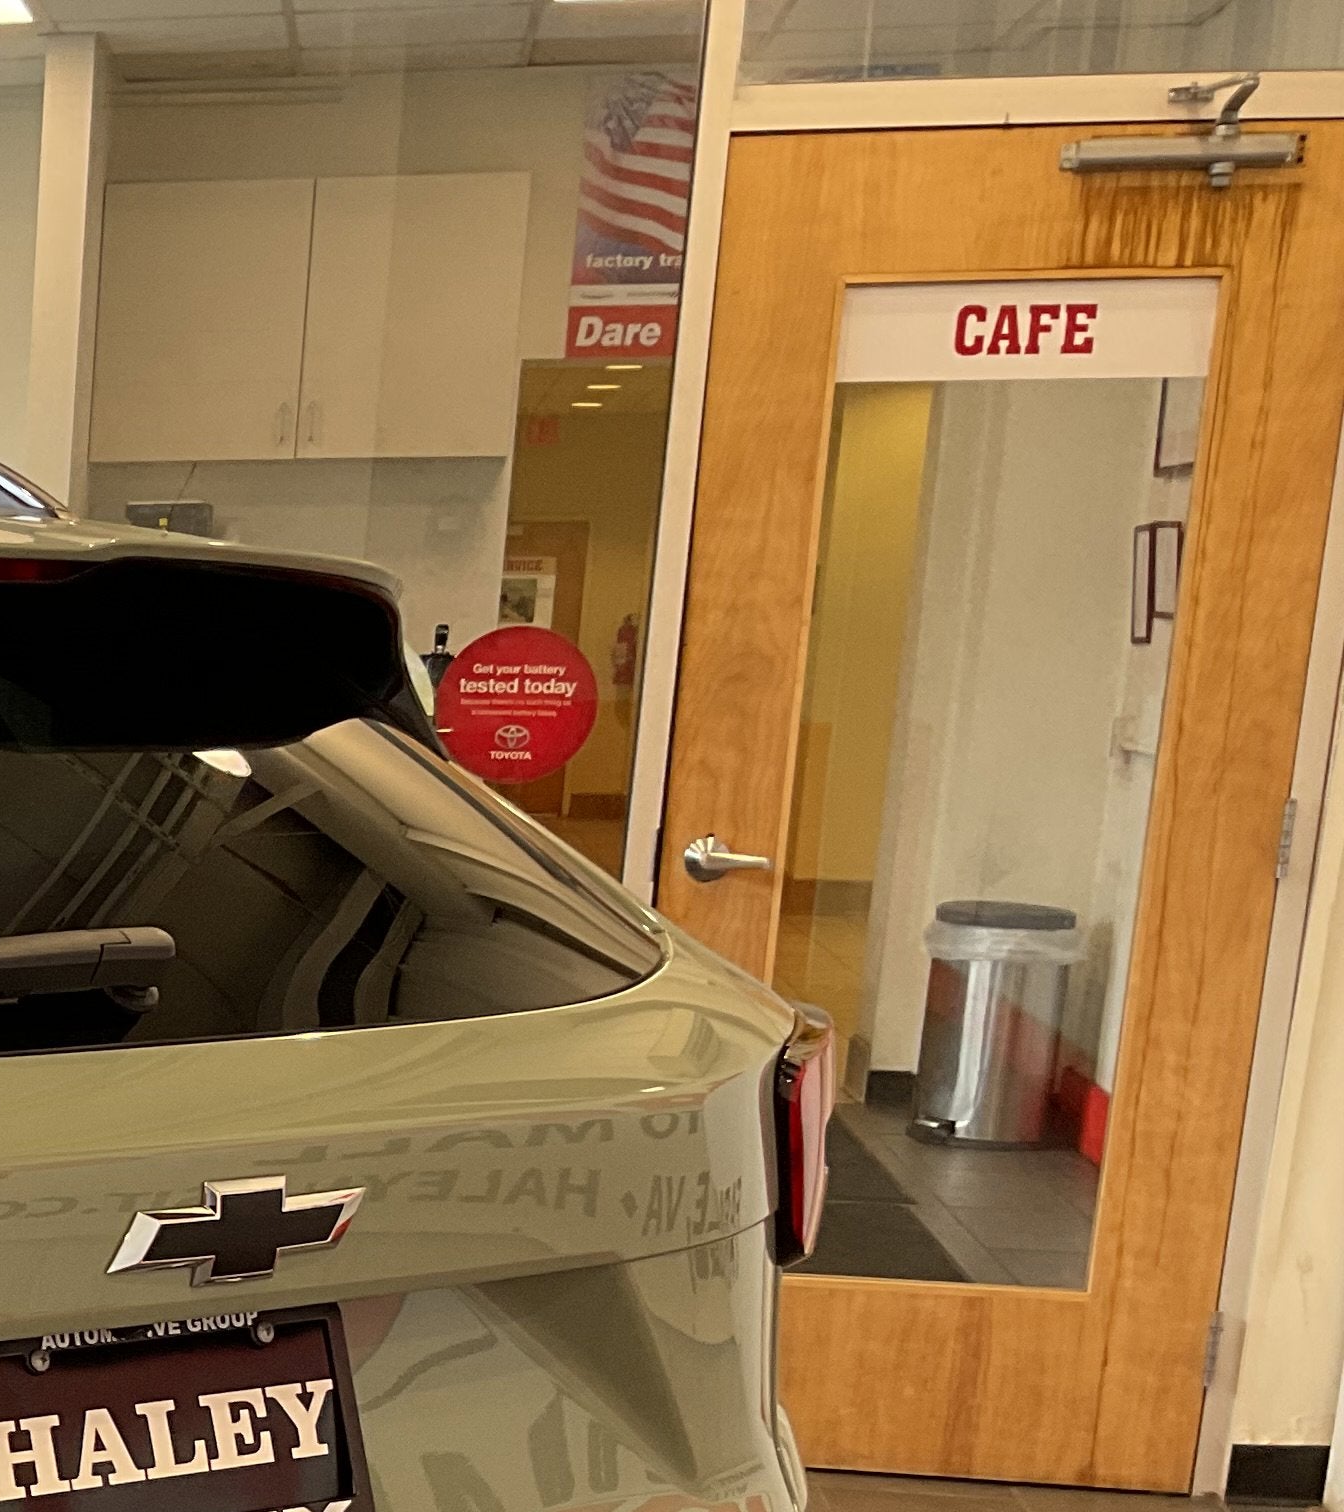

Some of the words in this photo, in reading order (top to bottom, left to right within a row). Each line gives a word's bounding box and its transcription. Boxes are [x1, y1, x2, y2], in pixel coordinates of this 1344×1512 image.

[586, 253, 654, 270] factory
[575, 315, 662, 348] Dare
[954, 303, 1099, 357] CAFE
[472, 663, 494, 674] Get
[496, 665, 522, 676] your
[523, 664, 566, 676] battery
[459, 678, 519, 694] tested
[524, 678, 577, 697] today
[490, 751, 532, 760] TOYOTA
[41, 1319, 182, 1350] AUTOMVE
[186, 1311, 258, 1333] GROUP
